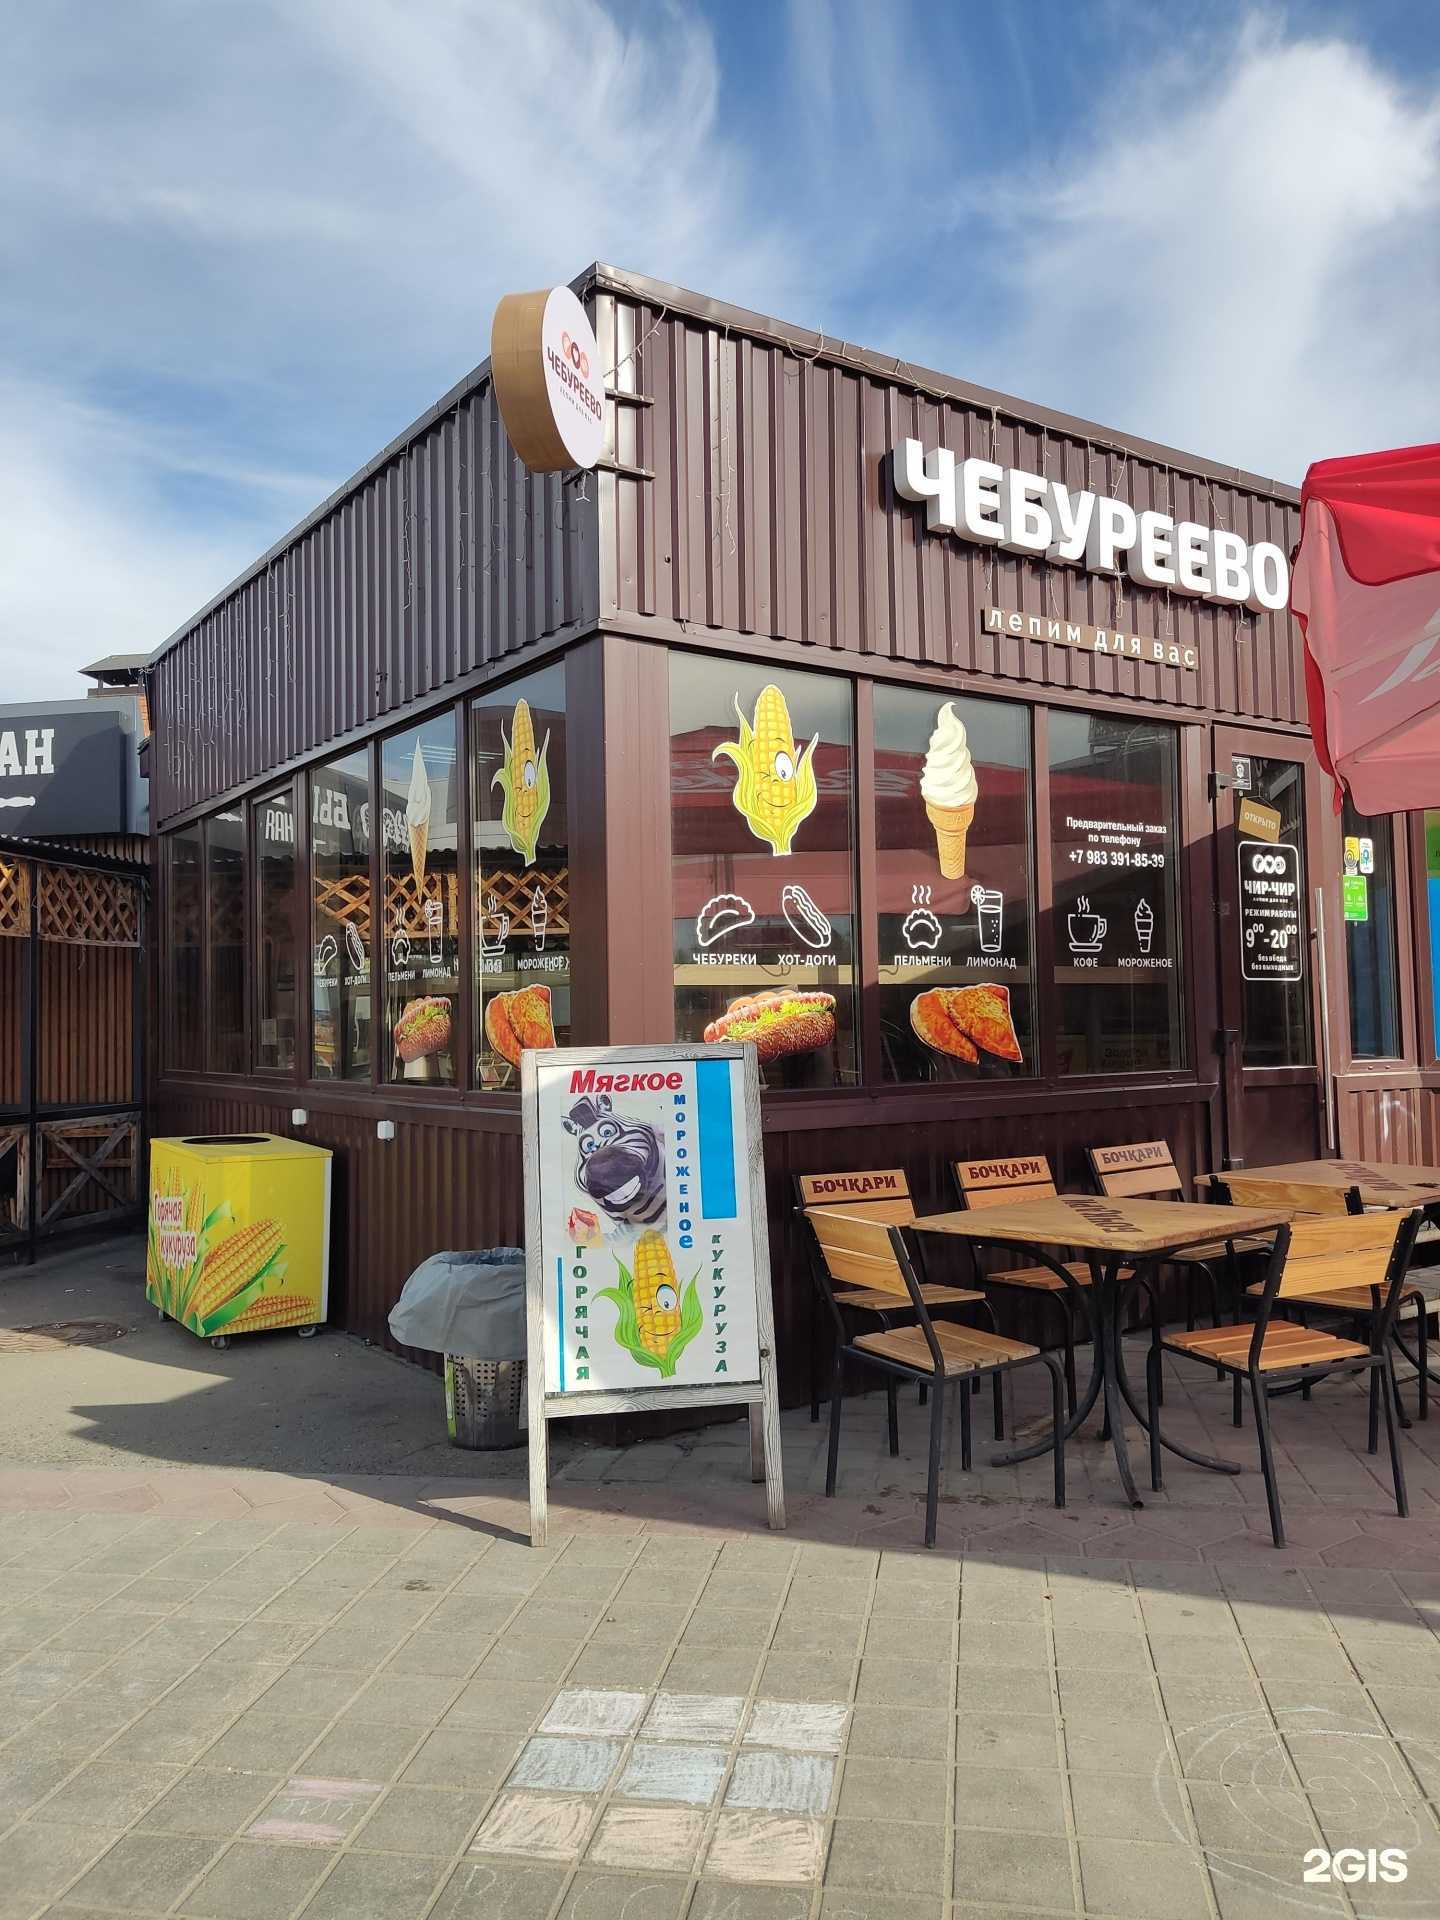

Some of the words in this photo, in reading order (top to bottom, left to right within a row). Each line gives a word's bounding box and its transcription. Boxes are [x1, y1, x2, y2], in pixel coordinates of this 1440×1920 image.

[547, 346, 602, 421] ЧЕБУРЕЕВО
[892, 437, 1289, 615] ЧЕБУРЕЕВО
[988, 608, 1081, 645] лепим
[1095, 628, 1141, 655] для
[1153, 640, 1195, 667] вас
[0, 728, 55, 776] АН
[1066, 816, 1144, 833] Предварительный
[1145, 824, 1167, 834] заказ
[1244, 811, 1277, 830] ОТКРЫТО
[1088, 834, 1099, 843] по
[1100, 835, 1141, 847] телефону
[1069, 849, 1084, 864] +7
[1086, 850, 1108, 865] 983
[1110, 851, 1165, 868] 391-85-39
[1244, 880, 1296, 896] ЧИР-ЧИР
[1245, 908, 1270, 917] РЕЖИМ
[1270, 909, 1297, 919] РАБОТЫ
[692, 953, 757, 966] ЧЕБУРЕКИ
[777, 954, 837, 967] ХОТ-ДОГИ
[893, 954, 952, 968] ПЕЛЬМЕНИ
[966, 956, 1017, 969] ЛИМОНАД
[1073, 957, 1099, 968] КОФЕ
[1117, 957, 1173, 968] МОРОЖЕНОЕ
[569, 1069, 684, 1094] Мягкое
[1100, 1145, 1164, 1165] БОЧКАРИ
[968, 1159, 1041, 1180] БОЧКАРИ
[811, 1174, 897, 1195] БОЧКАРИ
[572, 1246, 590, 1381] ГОРЯЧАЯ
